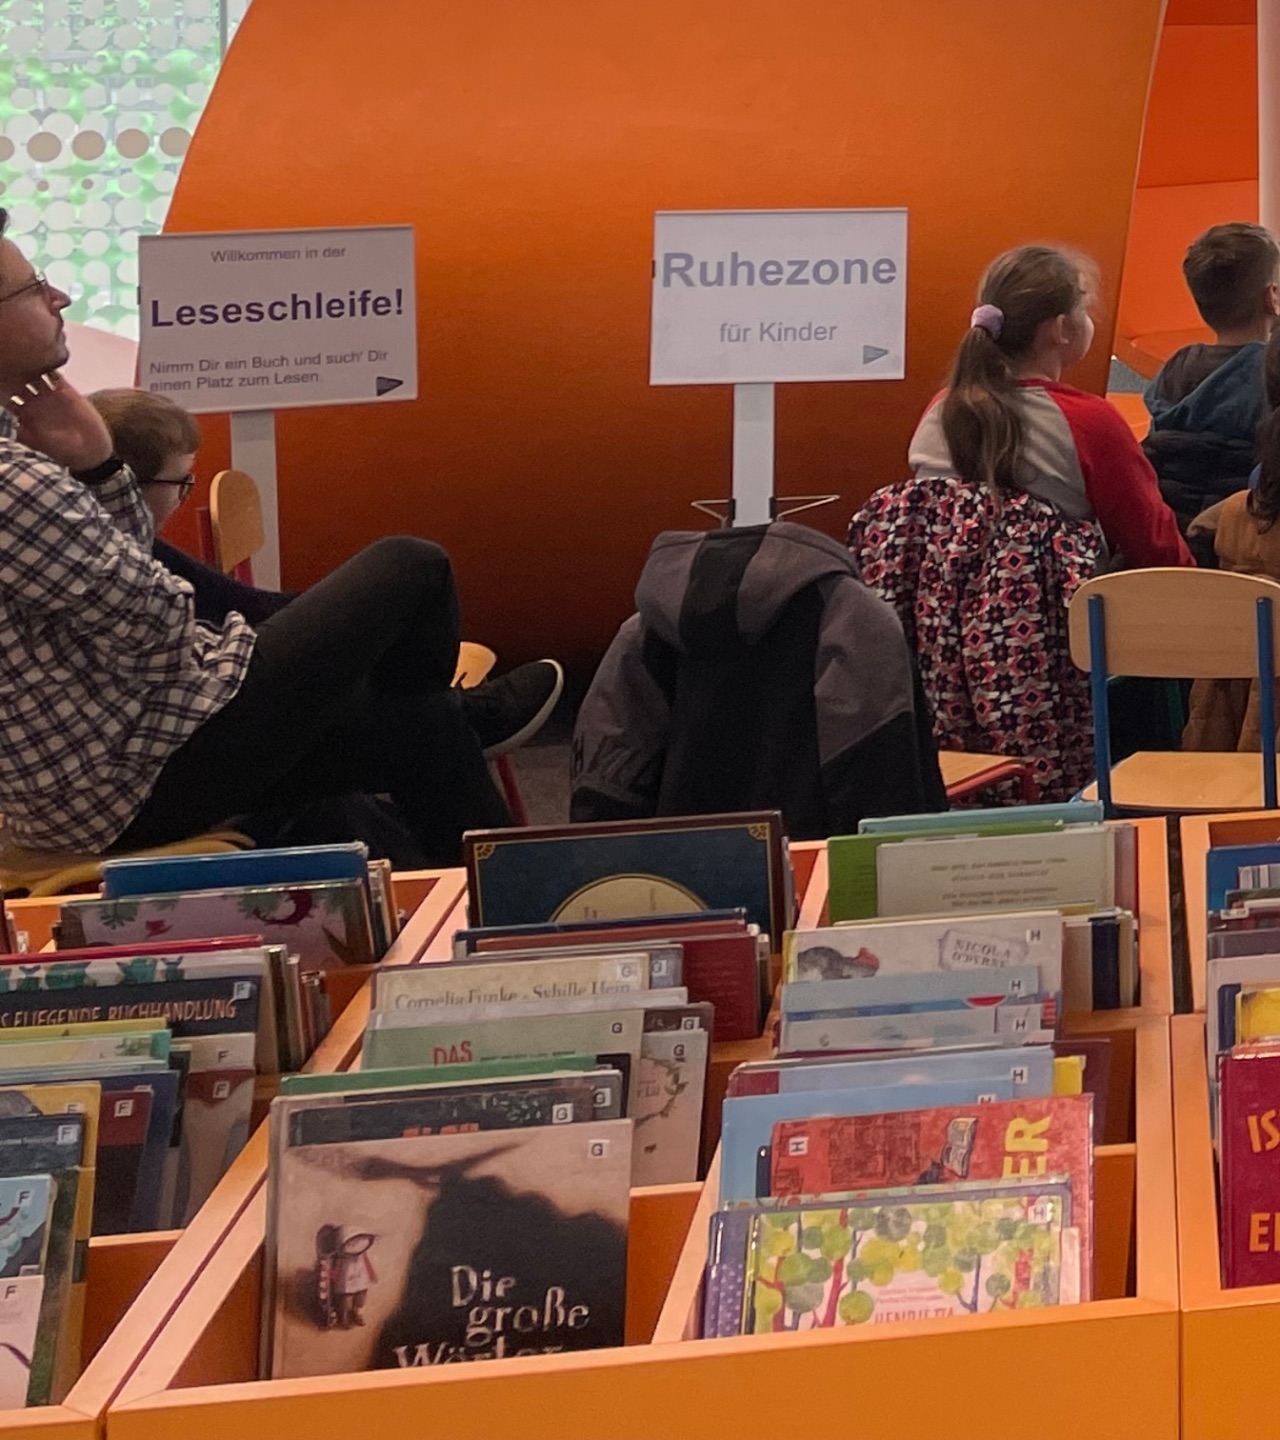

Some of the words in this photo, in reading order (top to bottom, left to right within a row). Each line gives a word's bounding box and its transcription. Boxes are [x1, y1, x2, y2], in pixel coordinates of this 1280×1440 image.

[210, 248, 301, 264] Willkommen
[304, 247, 319, 260] in
[321, 246, 347, 259] der
[661, 251, 898, 289] Ruhezone
[150, 288, 404, 328] Leseschleife!
[719, 321, 752, 344] für
[758, 321, 839, 343] Kinder
[149, 361, 195, 375] Nimm
[199, 358, 220, 373] Dir
[224, 357, 248, 371] ein
[251, 355, 290, 370] Buch
[293, 352, 322, 367] und
[367, 349, 389, 363] Dir
[149, 379, 192, 392] einen
[195, 374, 235, 390] Platz
[237, 375, 270, 388] zum
[1030, 929, 1041, 942] H
[1010, 979, 1022, 992] H
[611, 1021, 623, 1034] G
[1015, 1018, 1026, 1031] H
[432, 1040, 474, 1066] DAS
[673, 1044, 686, 1057] G
[1013, 1068, 1024, 1082] H
[117, 1100, 131, 1115] F
[555, 1107, 568, 1121] G
[60, 1126, 73, 1141] F
[590, 1143, 604, 1158] G
[18, 1190, 31, 1205] F
[4, 1285, 18, 1300] F
[450, 1264, 516, 1308] Die
[465, 1285, 590, 1348] große
